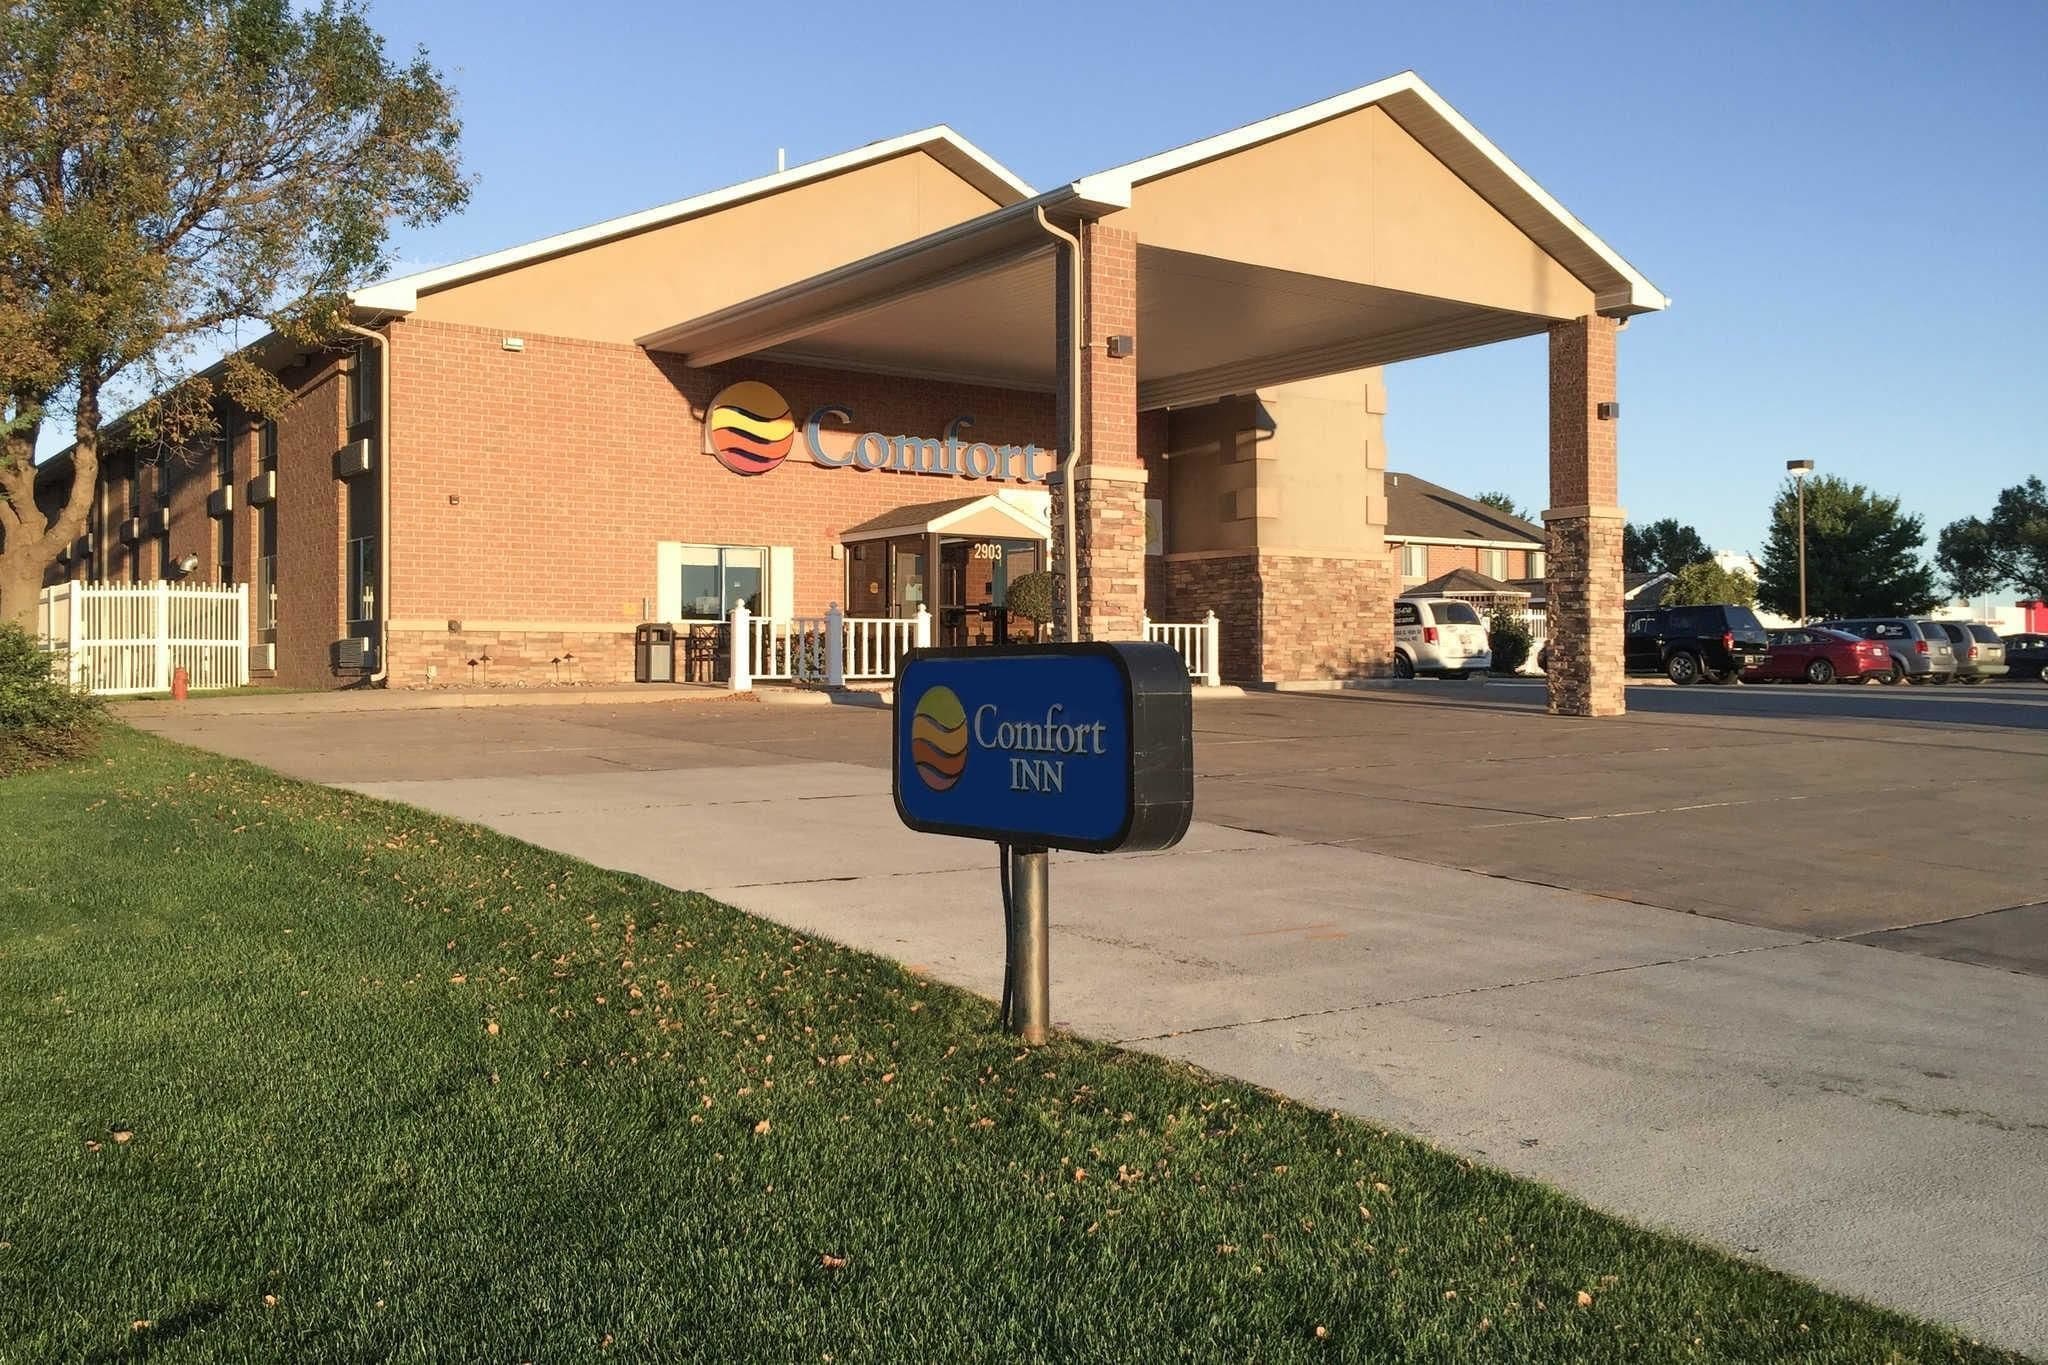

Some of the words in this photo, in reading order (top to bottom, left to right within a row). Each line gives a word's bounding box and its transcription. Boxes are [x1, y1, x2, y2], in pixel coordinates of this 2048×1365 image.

[803, 405, 1046, 481] Comfort
[974, 543, 1002, 560] 2903
[974, 703, 1107, 755] Comfort
[1009, 758, 1064, 793] INN
